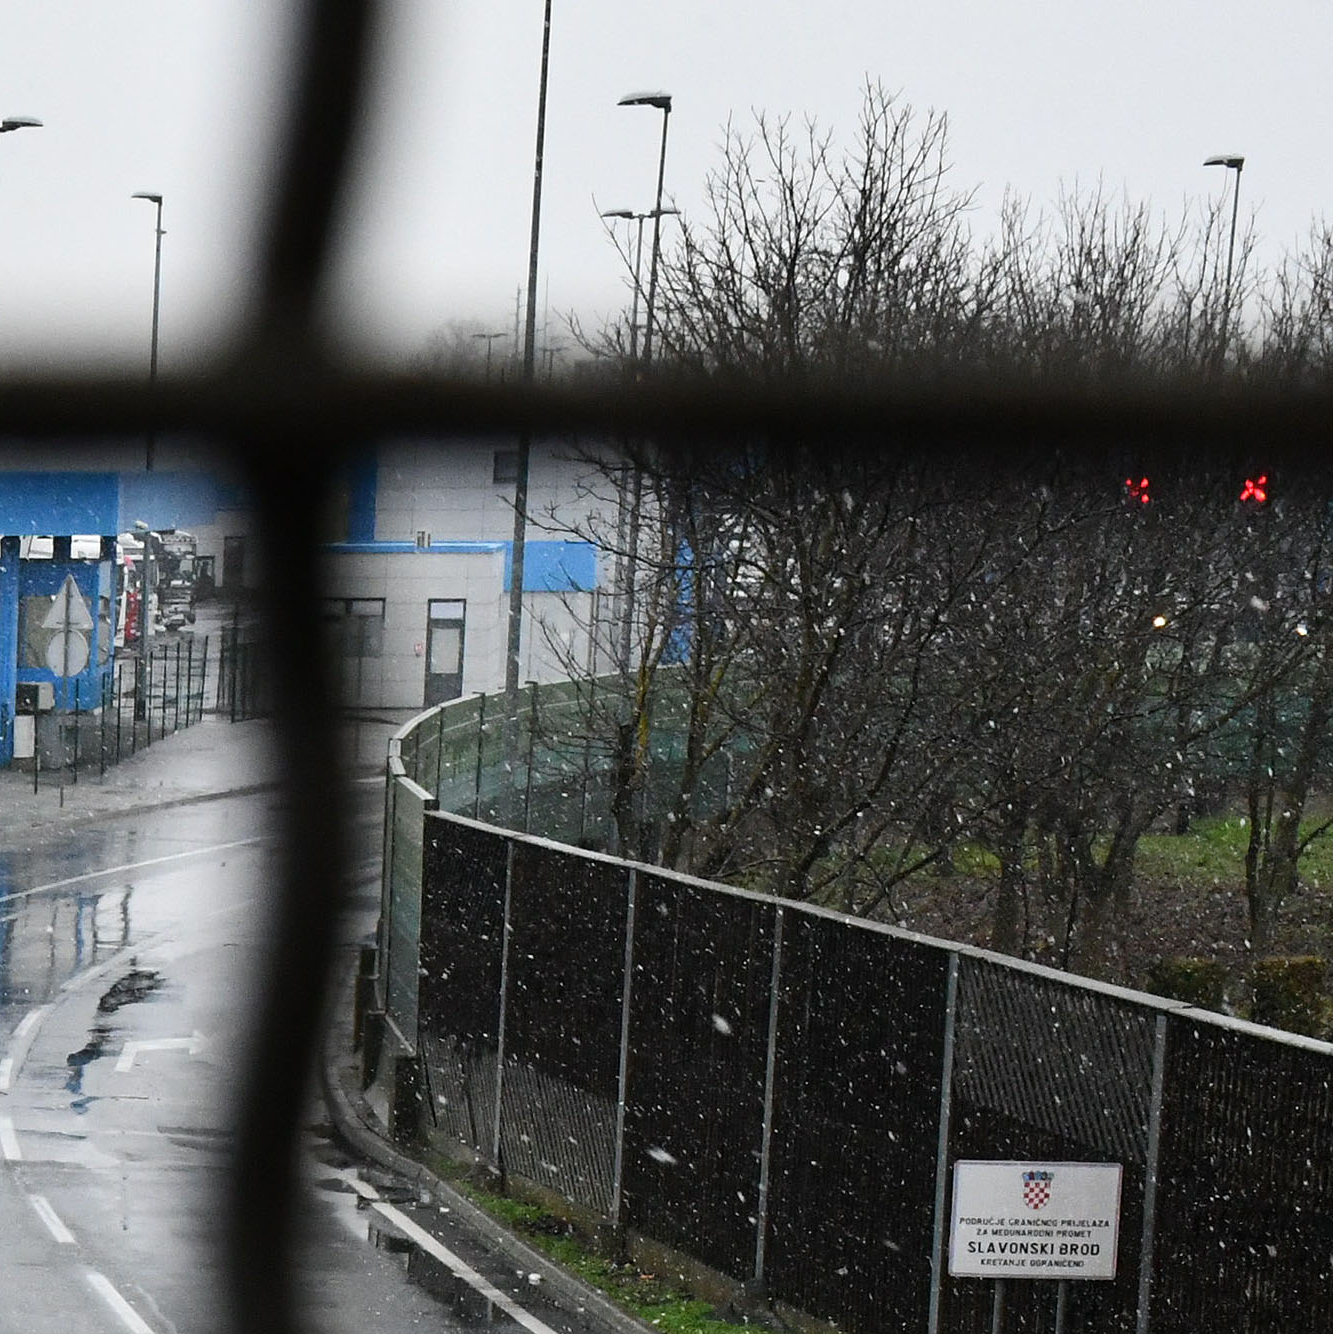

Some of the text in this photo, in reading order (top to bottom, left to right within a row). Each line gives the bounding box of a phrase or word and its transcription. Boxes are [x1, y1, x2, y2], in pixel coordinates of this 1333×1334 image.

[976, 1228, 988, 1236] ZA
[1056, 1230, 1092, 1238] PROMET
[967, 1241, 1100, 1256] SLAVONSKI BROD
[980, 1259, 1026, 1267] KRETANJE
